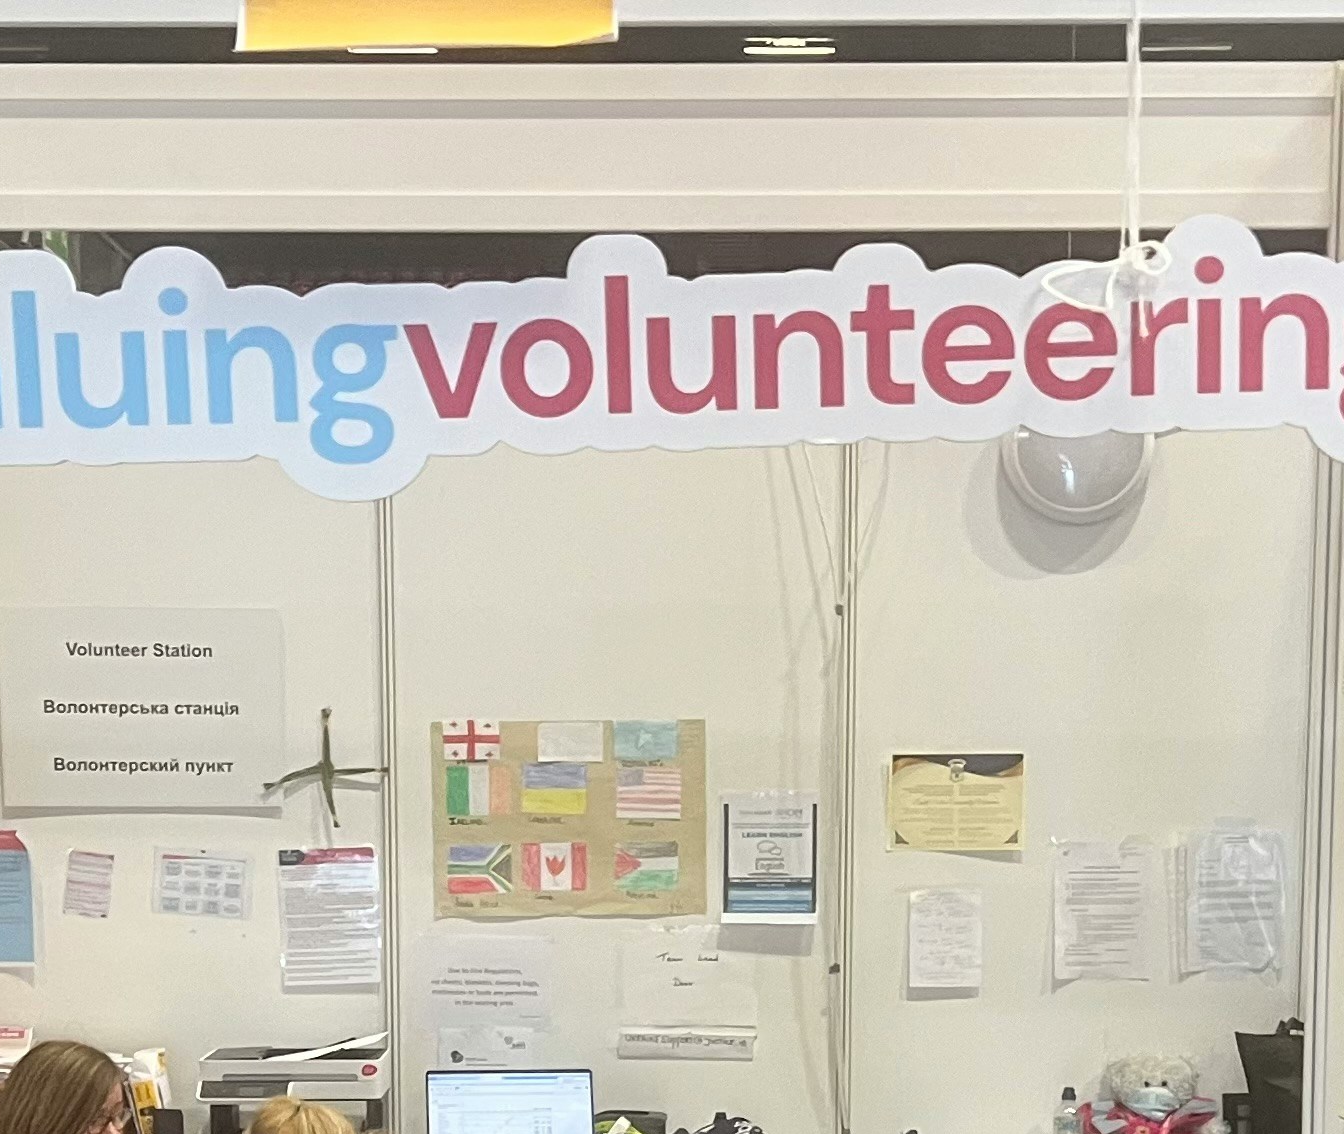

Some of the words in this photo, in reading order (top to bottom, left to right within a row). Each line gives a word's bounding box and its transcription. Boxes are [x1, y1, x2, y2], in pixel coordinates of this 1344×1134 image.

[66, 642, 148, 658] Volunteer
[153, 643, 213, 658] Station
[43, 699, 169, 717] Волонтерська
[174, 702, 240, 717] станція
[53, 757, 180, 775] Волонтерский
[185, 760, 234, 775] пункт
